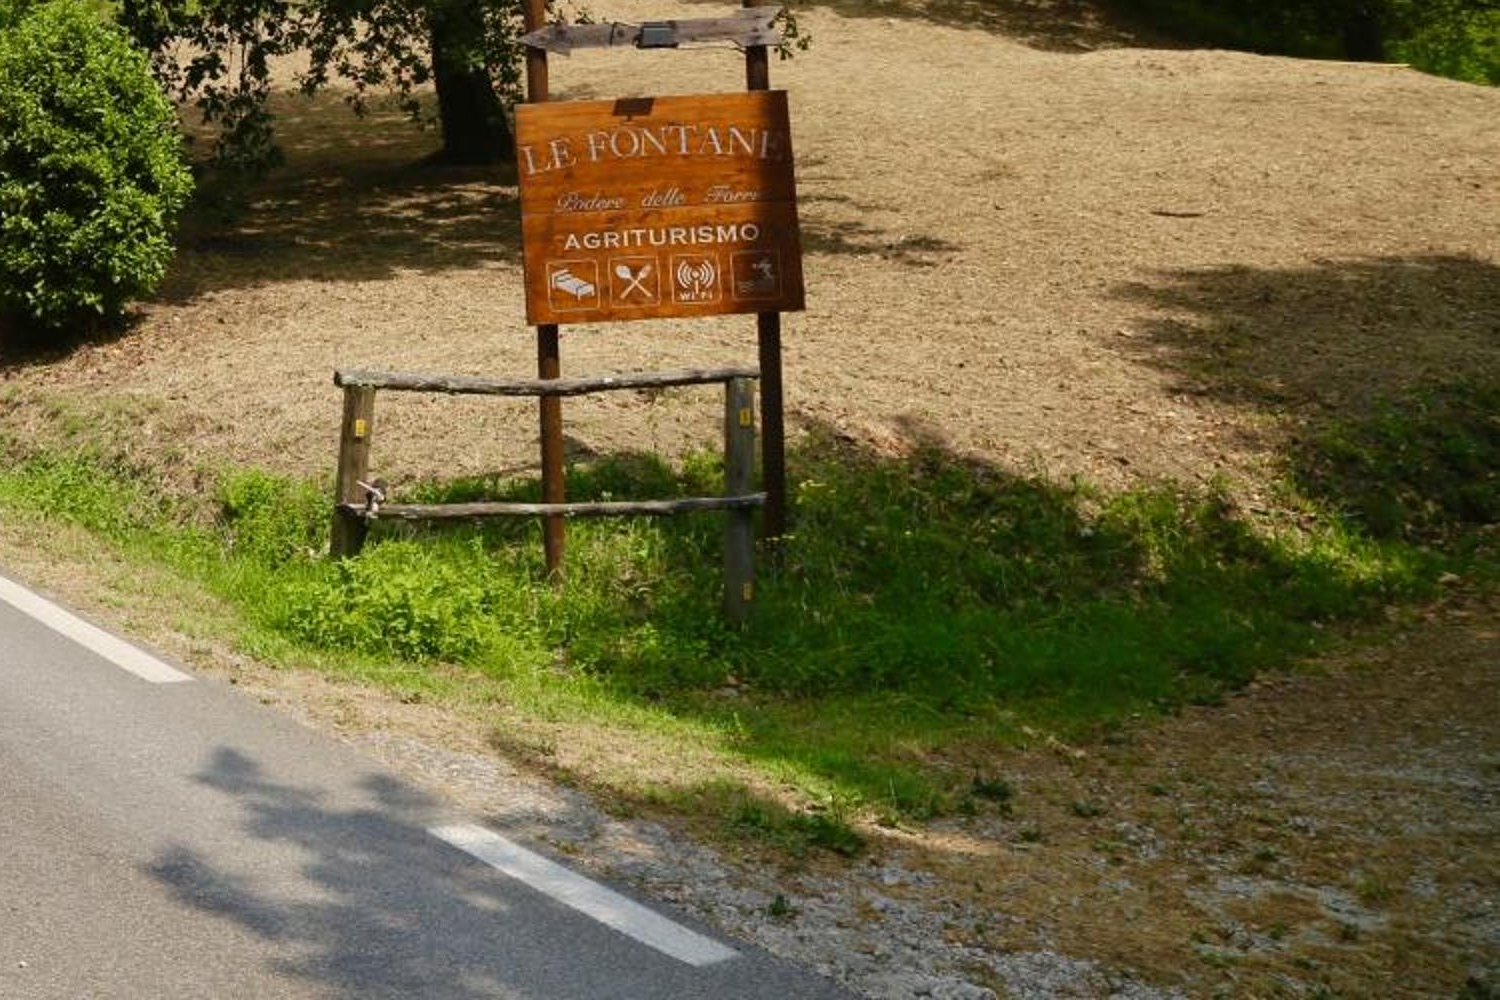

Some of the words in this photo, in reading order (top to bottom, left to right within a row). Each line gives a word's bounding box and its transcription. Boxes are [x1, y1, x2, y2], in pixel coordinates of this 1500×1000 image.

[521, 138, 577, 175] LE
[641, 185, 686, 208] delle
[564, 224, 760, 250] AGRITURISMO
